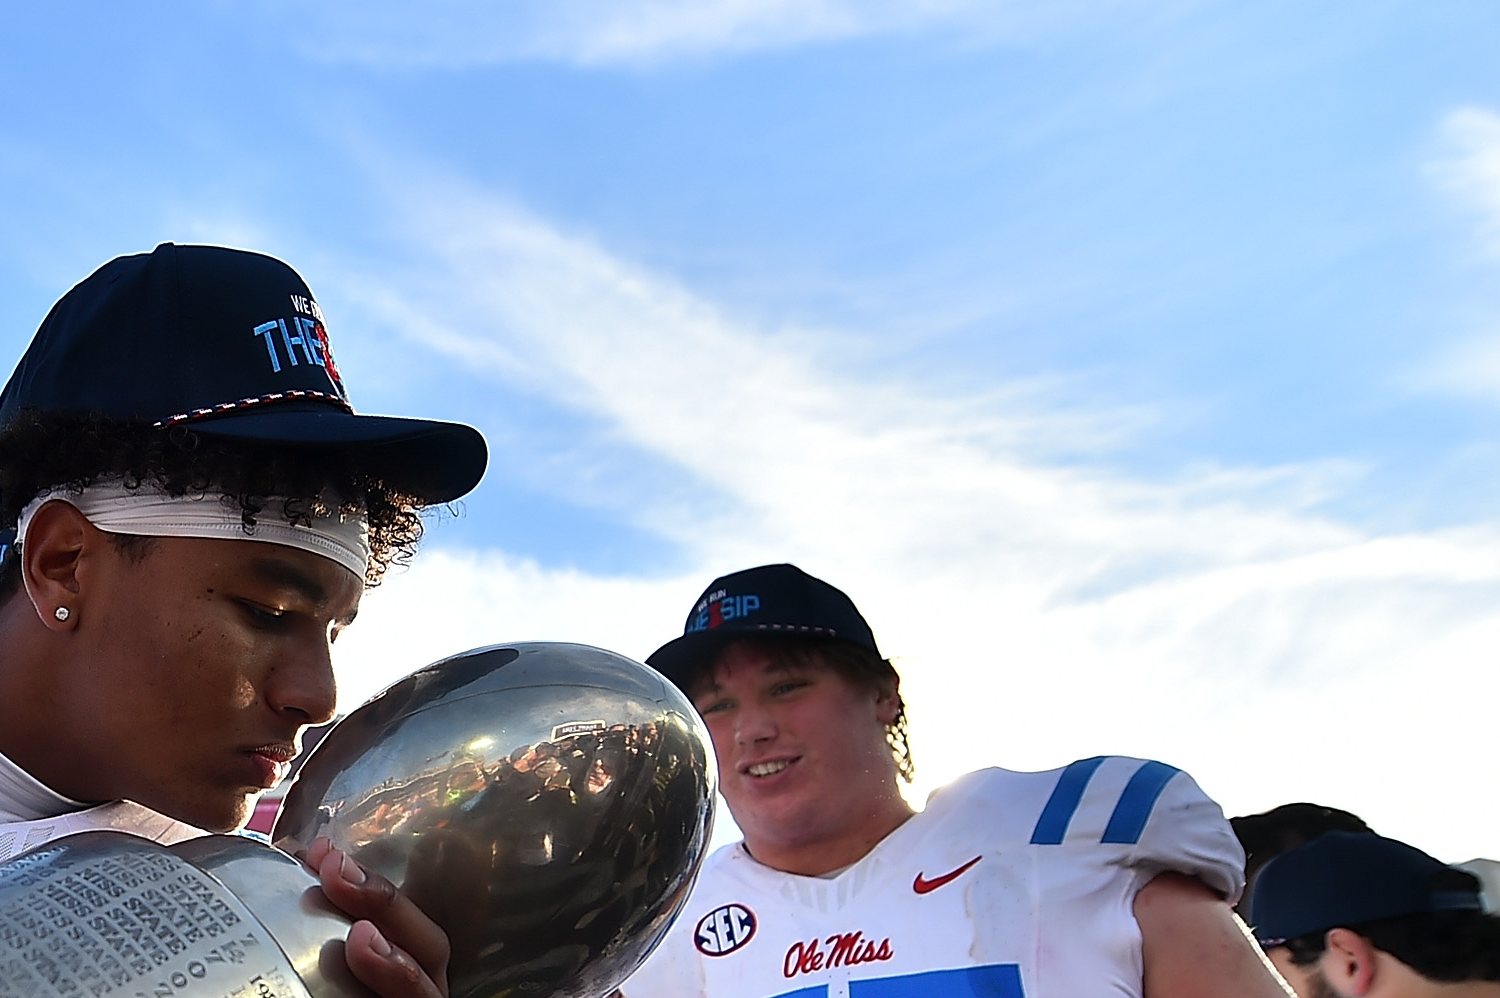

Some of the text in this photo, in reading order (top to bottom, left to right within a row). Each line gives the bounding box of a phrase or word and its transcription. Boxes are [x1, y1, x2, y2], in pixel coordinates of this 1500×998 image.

[290, 294, 311, 314] WE
[253, 316, 325, 373] THE
[709, 588, 726, 604] RUN
[721, 594, 760, 621] SIP
[121, 895, 187, 956] STATE
[187, 960, 206, 979] 0
[140, 886, 204, 944] STATE
[203, 947, 226, 964] 7
[161, 881, 226, 939] STATE
[177, 871, 241, 929] STATE
[238, 931, 260, 948] 7
[698, 906, 752, 953] SEC
[86, 913, 154, 977] STATE
[105, 906, 170, 967] STATE
[170, 971, 188, 989] 0
[783, 930, 894, 978] Ole Miss
